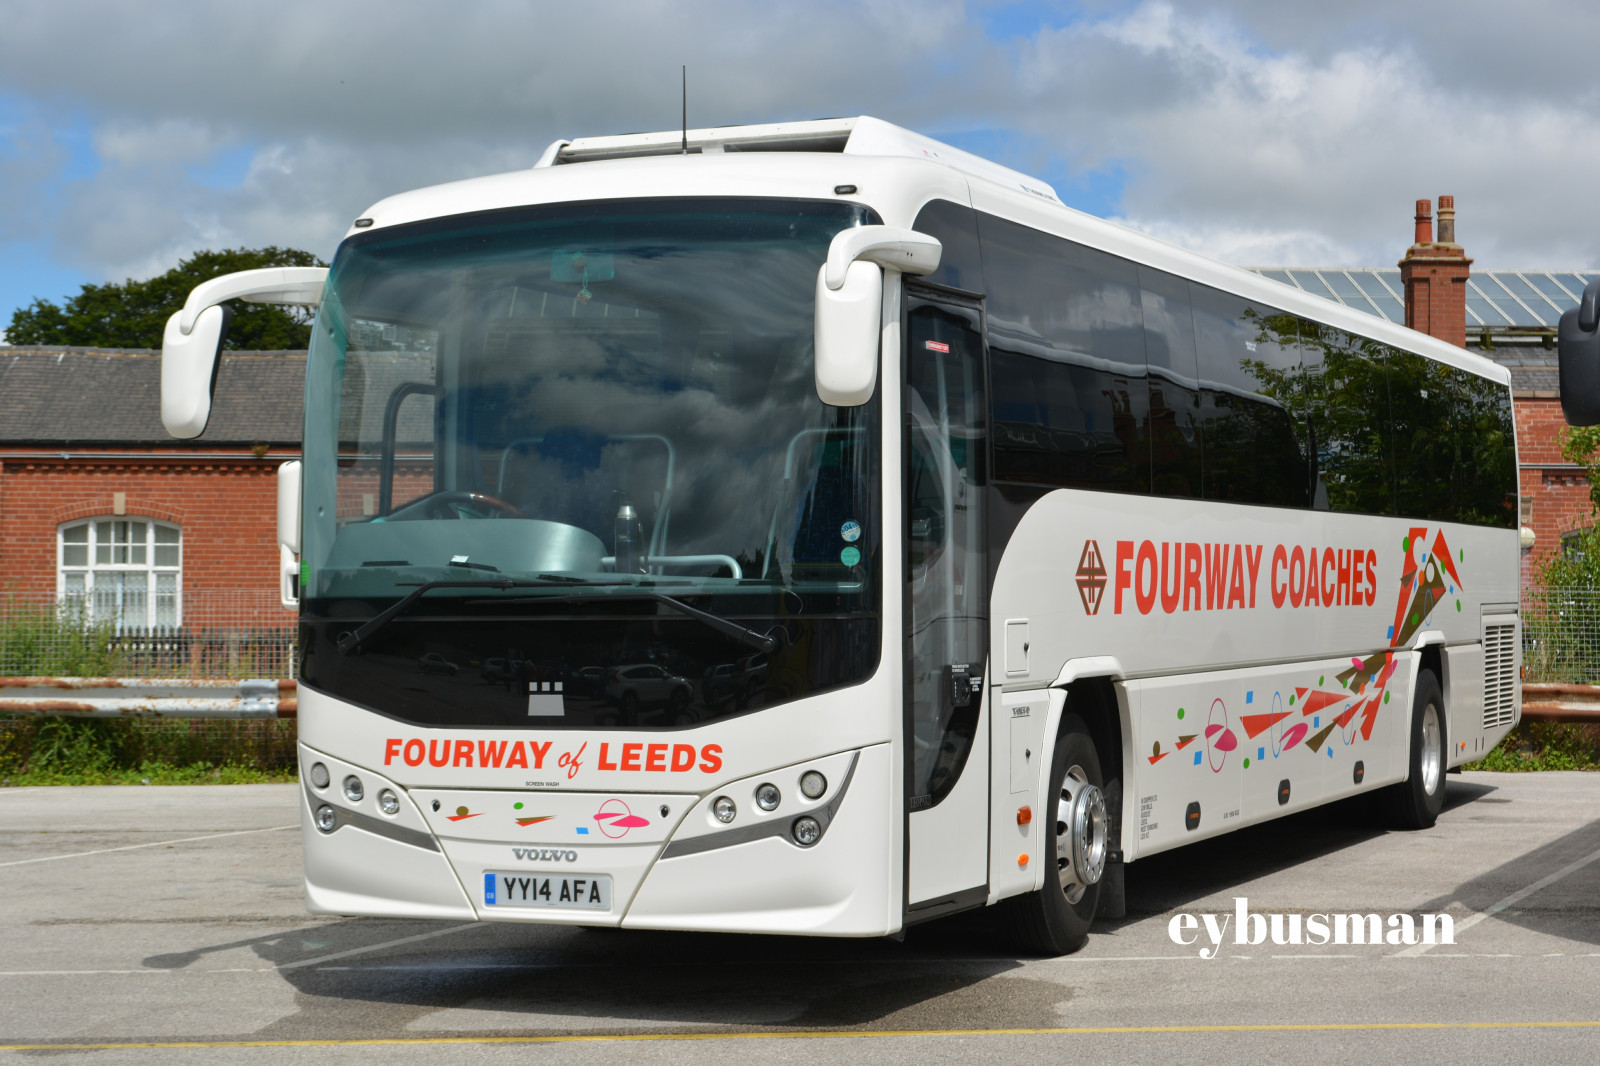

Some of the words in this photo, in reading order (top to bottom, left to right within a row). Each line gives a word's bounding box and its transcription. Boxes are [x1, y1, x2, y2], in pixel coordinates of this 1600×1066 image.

[1113, 539, 1264, 616] FOURWAY
[1270, 542, 1378, 609] COACHES
[384, 738, 553, 770] FOURWAY
[558, 740, 588, 780] of
[597, 742, 724, 774] LEEDS
[512, 847, 578, 863] VOLVO
[503, 876, 552, 902] YY14
[559, 879, 602, 904] AFA
